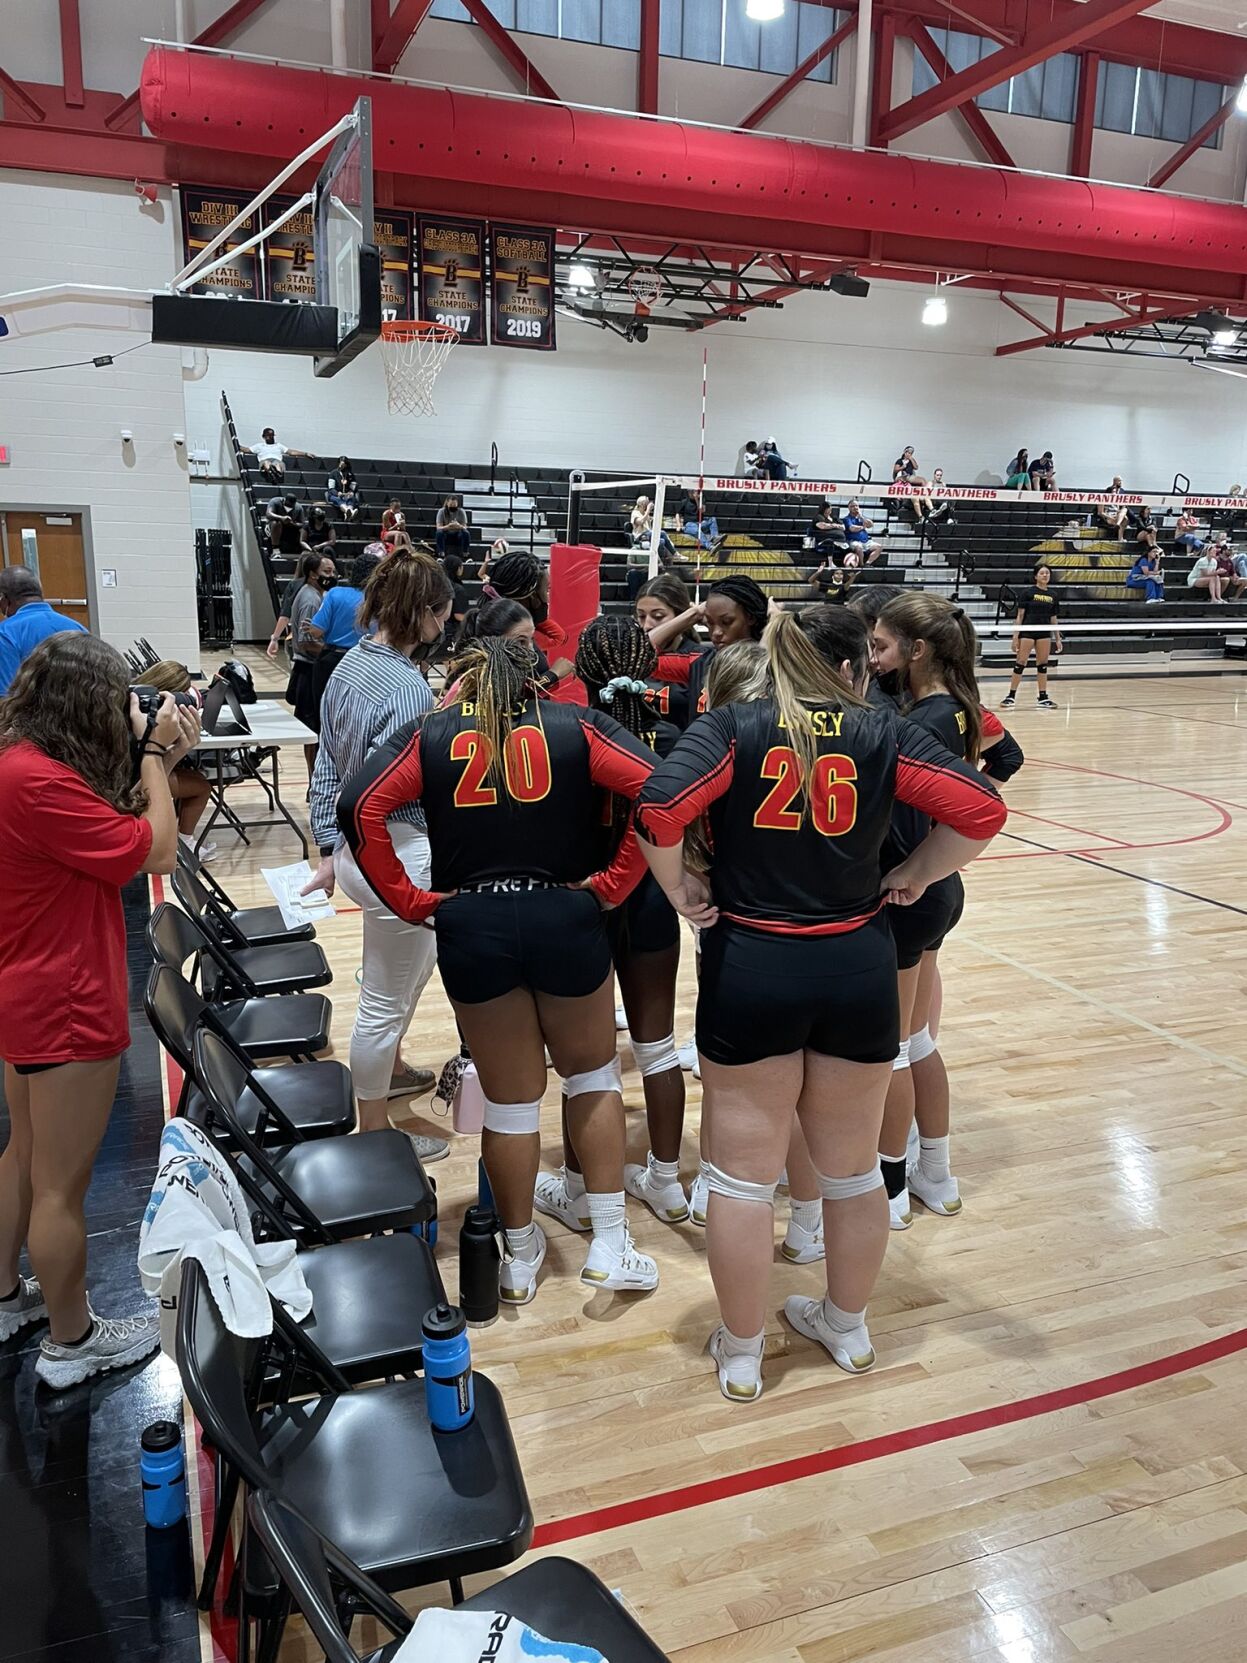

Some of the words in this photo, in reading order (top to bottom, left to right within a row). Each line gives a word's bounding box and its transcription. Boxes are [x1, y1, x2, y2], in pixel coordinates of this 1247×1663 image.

[202, 201, 223, 214] DIV
[425, 228, 460, 242] CLASS
[497, 236, 530, 250] CLASS
[497, 248, 547, 262] SOFTBALL
[209, 266, 240, 278] TATE
[198, 276, 252, 289] HAMPIONS
[274, 282, 316, 295] CHAMPIO
[438, 290, 467, 300] STATE
[511, 295, 537, 306] STATE
[427, 297, 479, 310] CHAMPIONS
[500, 304, 549, 317] CHAMPIONS
[507, 319, 541, 338] 2019
[716, 479, 767, 490] BRUSLY
[770, 482, 837, 493] PANTHERS
[888, 486, 933, 497] BRUSLY
[936, 488, 997, 499] PANTHERS
[1043, 492, 1087, 502] BRUSLY
[1087, 494, 1143, 504] PANTHERS
[1184, 497, 1222, 506] BRUSLY
[450, 725, 552, 807] 20
[753, 746, 858, 837] 26
